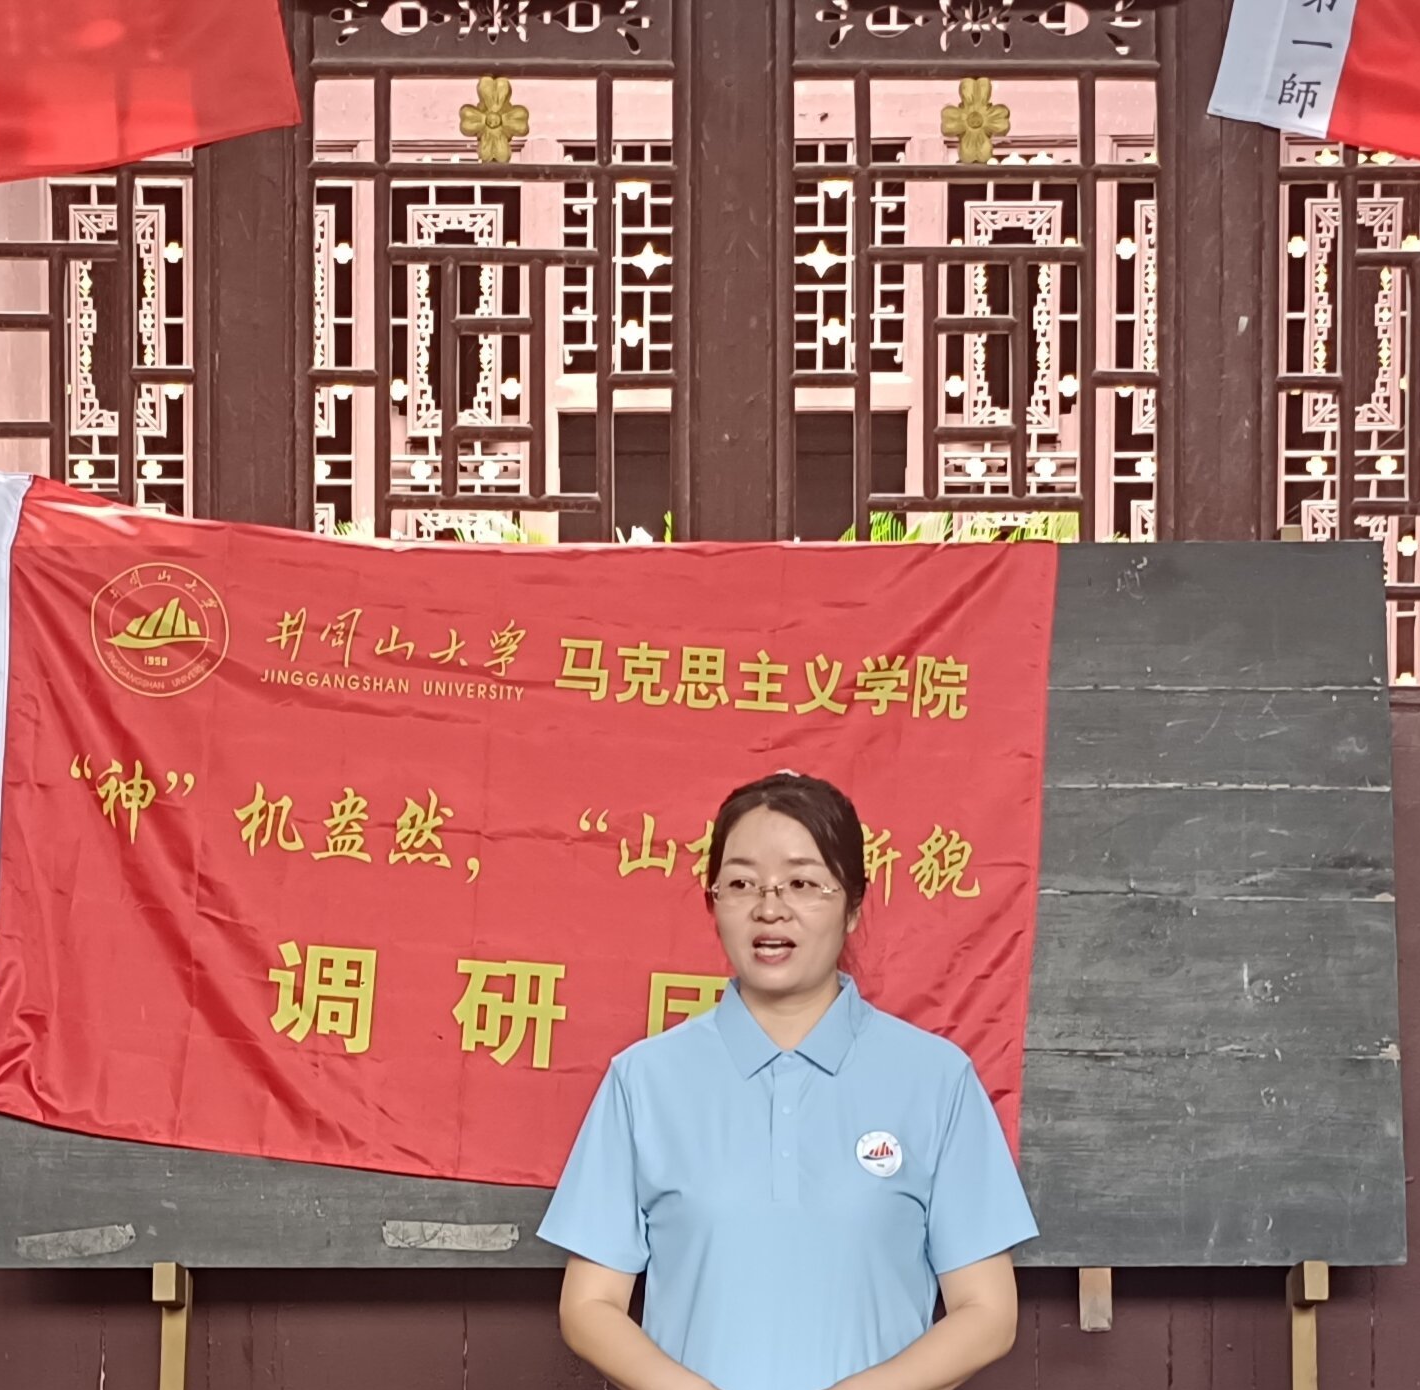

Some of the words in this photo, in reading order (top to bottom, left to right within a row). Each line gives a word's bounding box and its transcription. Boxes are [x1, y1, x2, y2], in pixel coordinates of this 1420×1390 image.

[260, 668, 410, 694] JINGGANGSHAN
[422, 680, 525, 702] UNIVERSITY
[554, 637, 969, 720] 马克思主义学院
